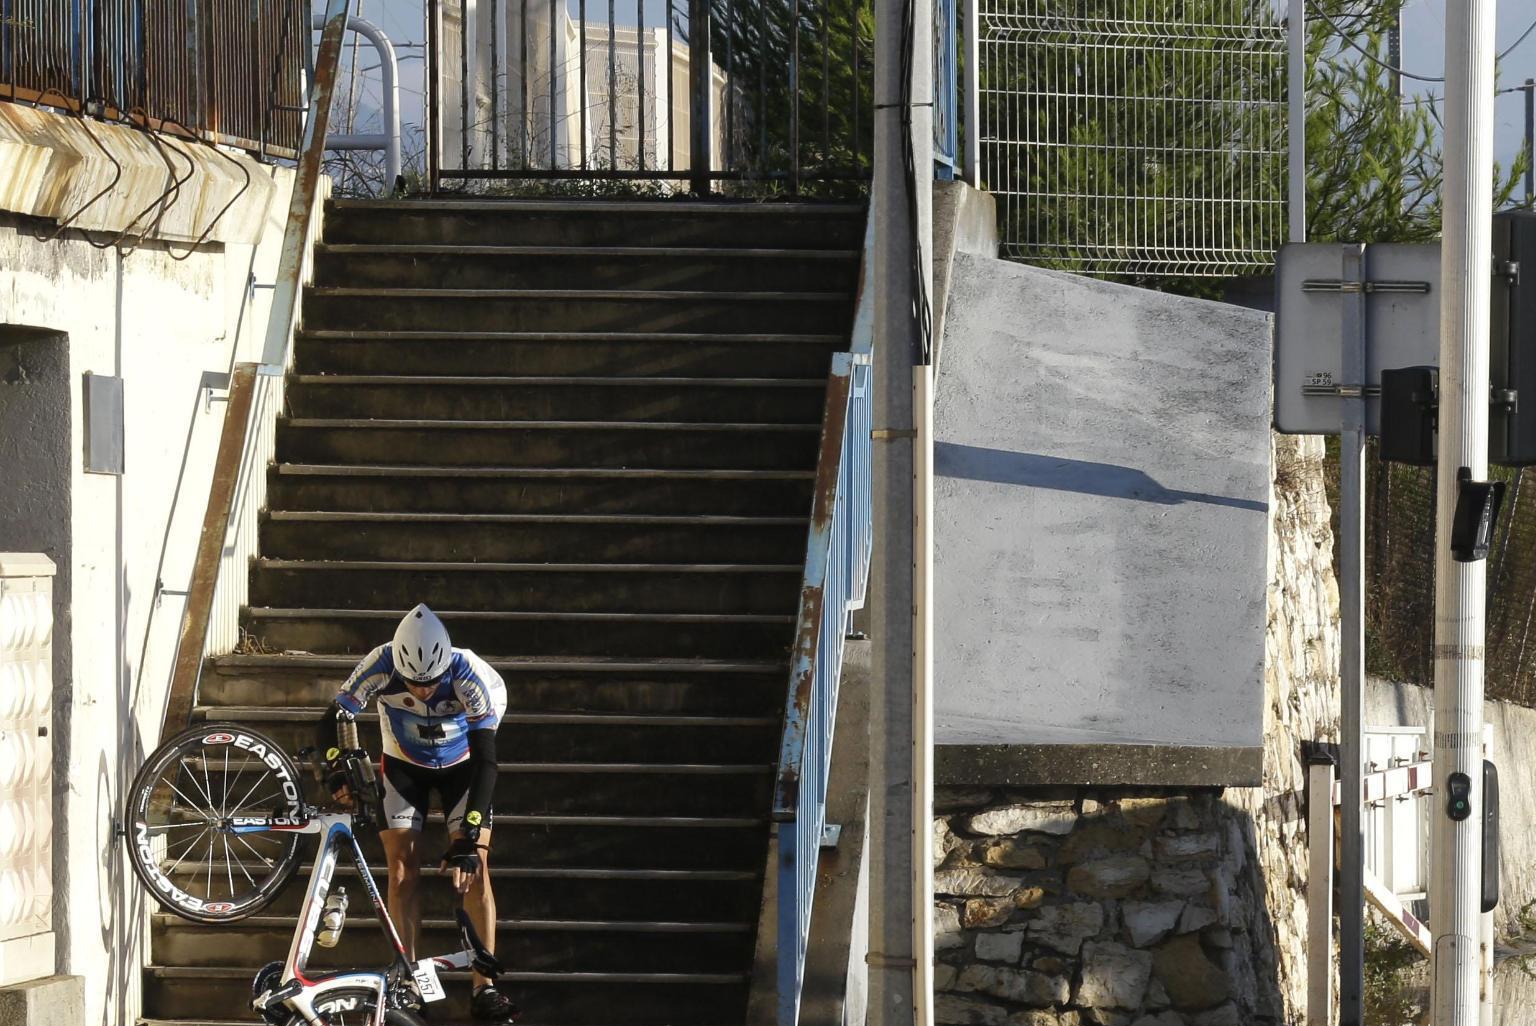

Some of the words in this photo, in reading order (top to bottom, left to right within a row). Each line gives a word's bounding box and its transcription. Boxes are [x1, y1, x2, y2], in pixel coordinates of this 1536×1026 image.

[234, 734, 299, 820] EASTON
[135, 822, 203, 911] EASTON
[415, 972, 434, 996] 1257
